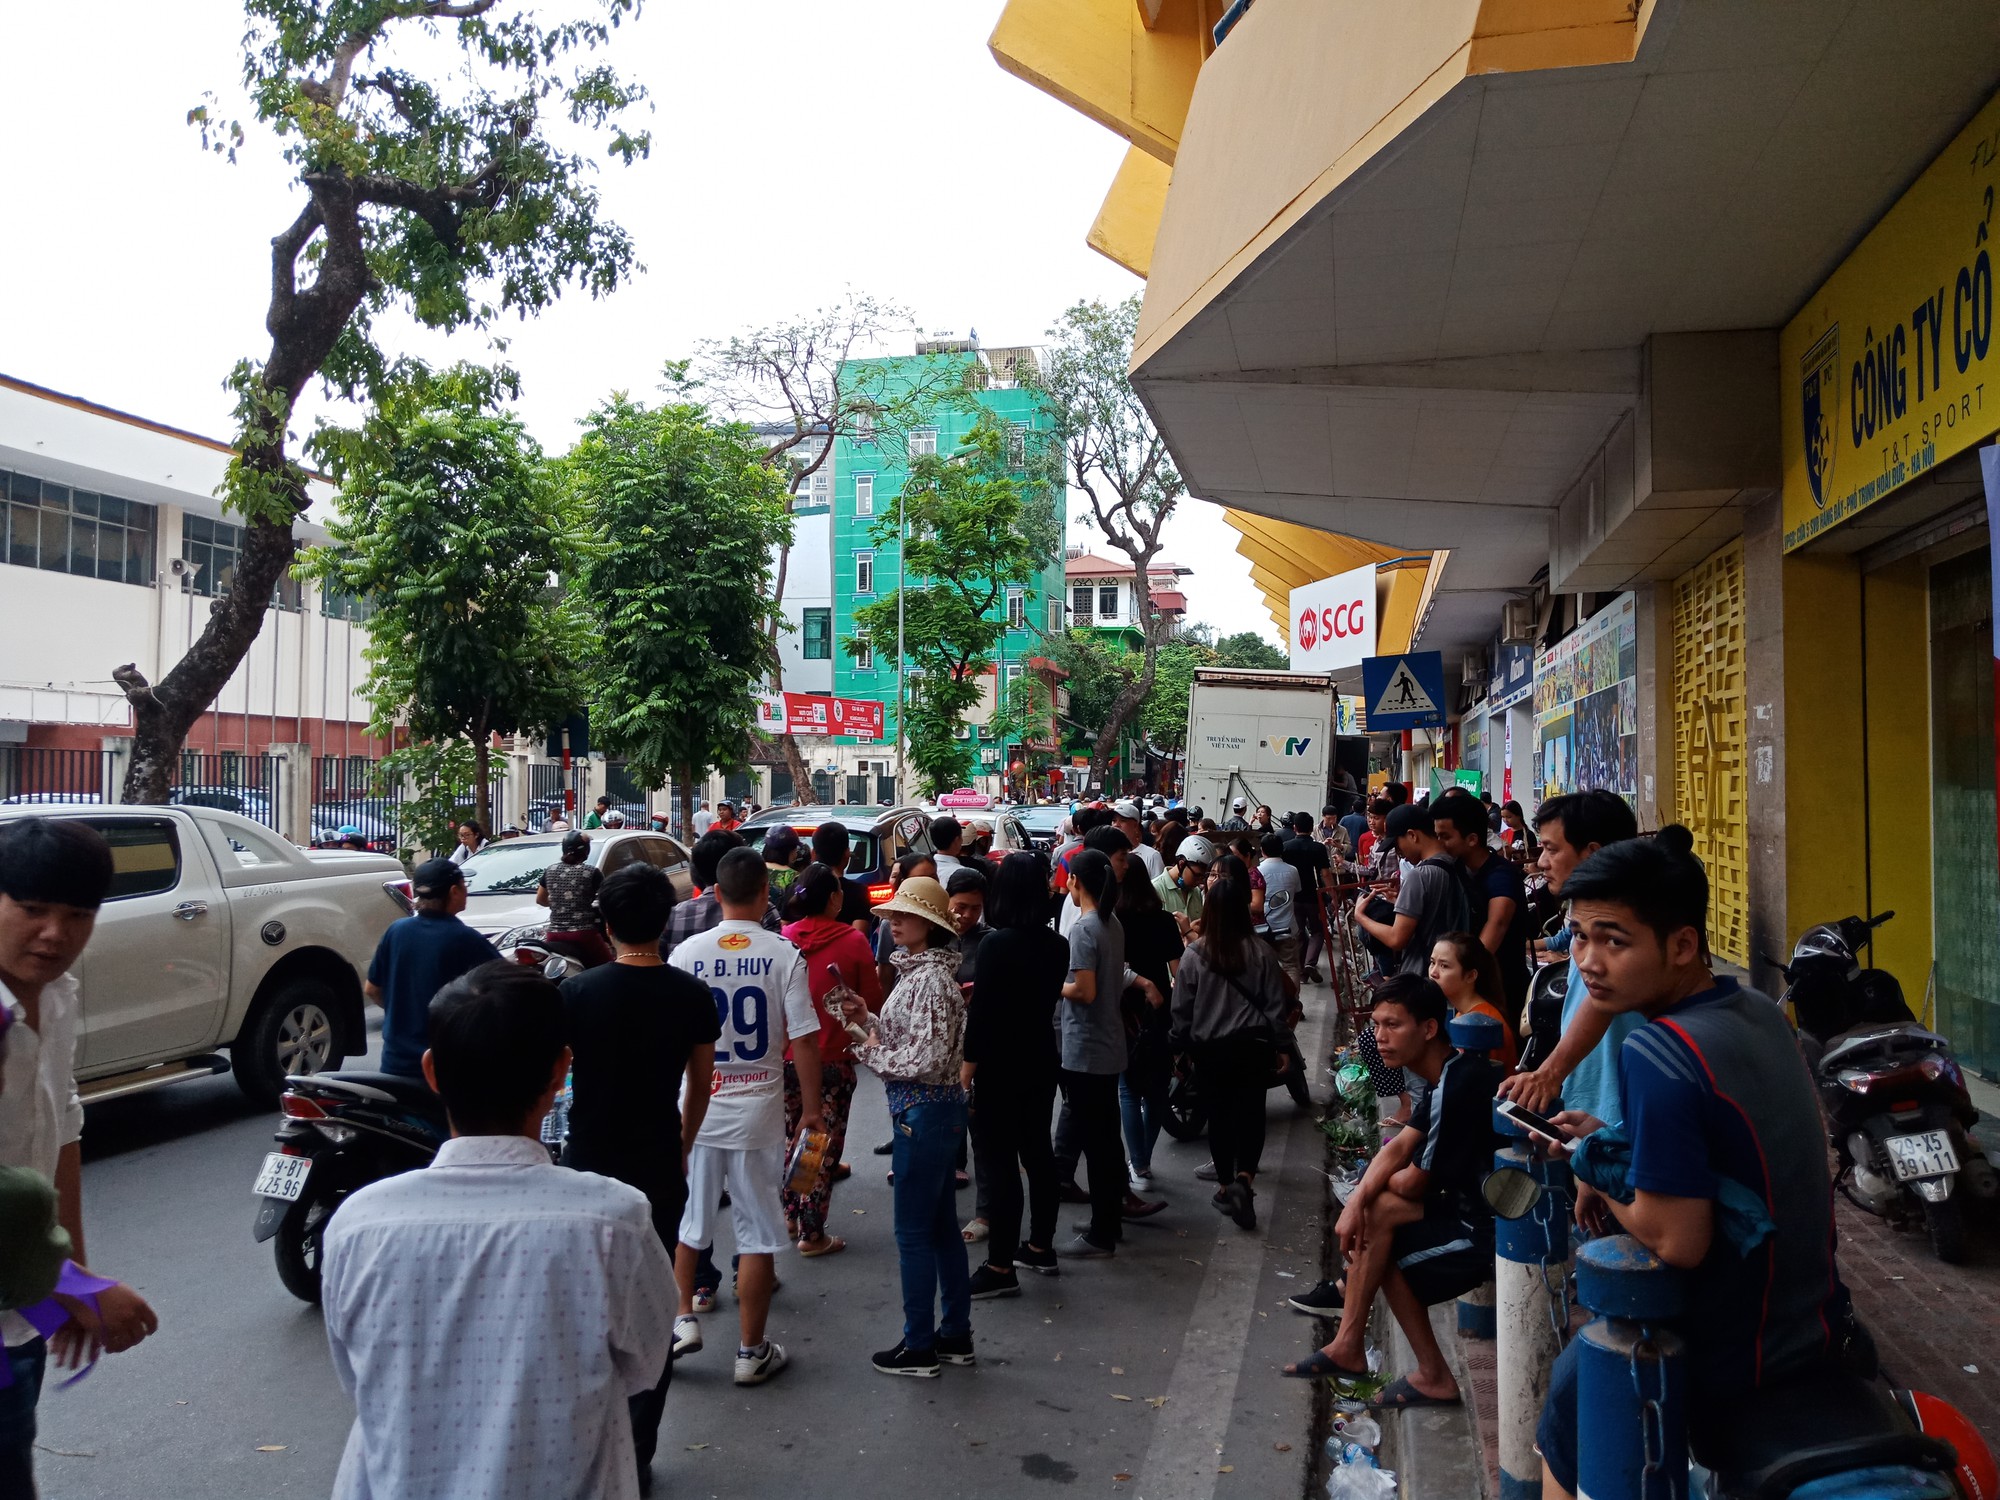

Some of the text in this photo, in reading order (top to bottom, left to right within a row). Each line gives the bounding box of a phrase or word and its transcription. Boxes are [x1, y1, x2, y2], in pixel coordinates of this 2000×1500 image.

[1851, 185, 1993, 449] CÔNG TY CỔ
[1922, 384, 1984, 444] SPORT
[1911, 449, 1920, 475] HÀ
[1922, 441, 1935, 468] NỘI
[1322, 600, 1364, 642] SCG
[1268, 735, 1312, 756] VTV
[694, 958, 774, 978] P. Đ. HUY
[711, 986, 769, 1062] 29
[1895, 1133, 1942, 1156] 29-X5
[268, 1157, 304, 1178] 29-B1
[1897, 1152, 1955, 1177] 391.11
[257, 1176, 300, 1198] 225.96
